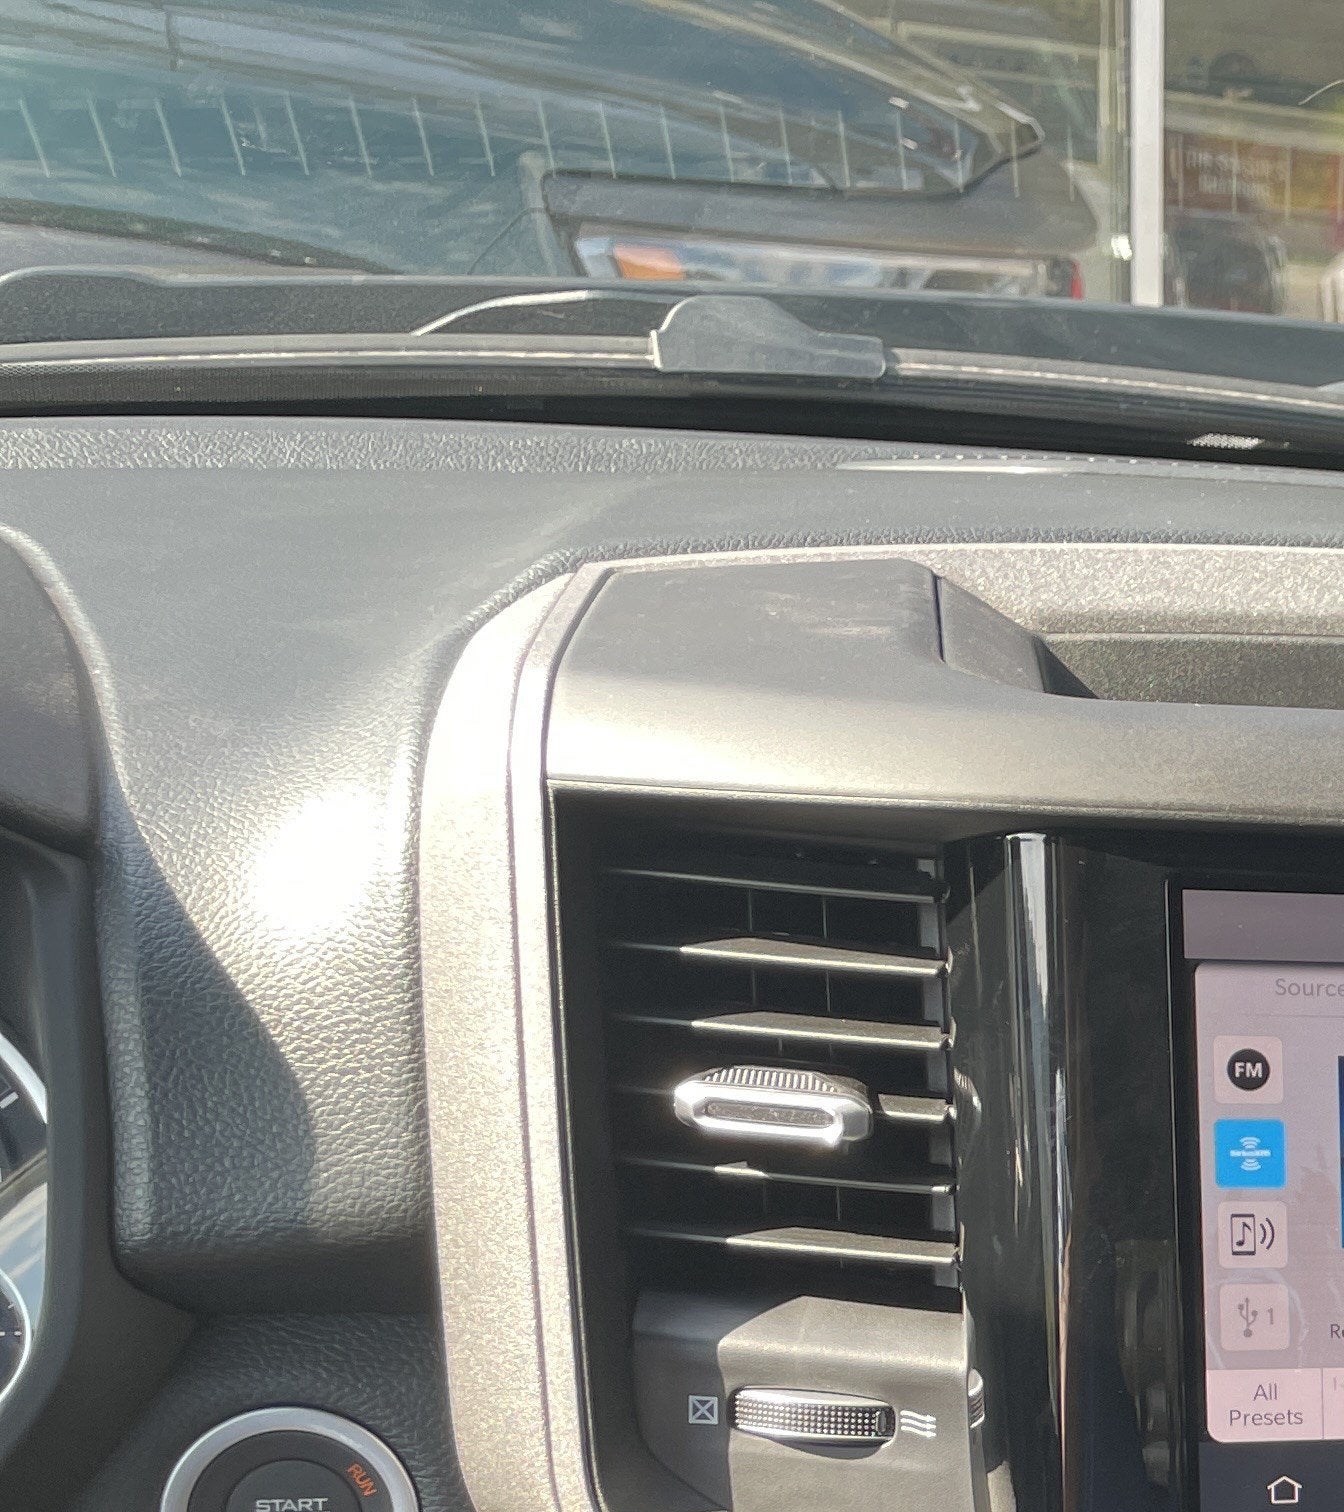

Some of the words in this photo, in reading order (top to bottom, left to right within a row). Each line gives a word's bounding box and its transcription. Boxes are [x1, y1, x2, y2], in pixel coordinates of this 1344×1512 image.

[1234, 1061, 1263, 1078] FM
[1253, 1383, 1278, 1401] All
[1229, 1408, 1304, 1427] Presets
[347, 1463, 377, 1497] RUN
[255, 1497, 328, 1512] START
